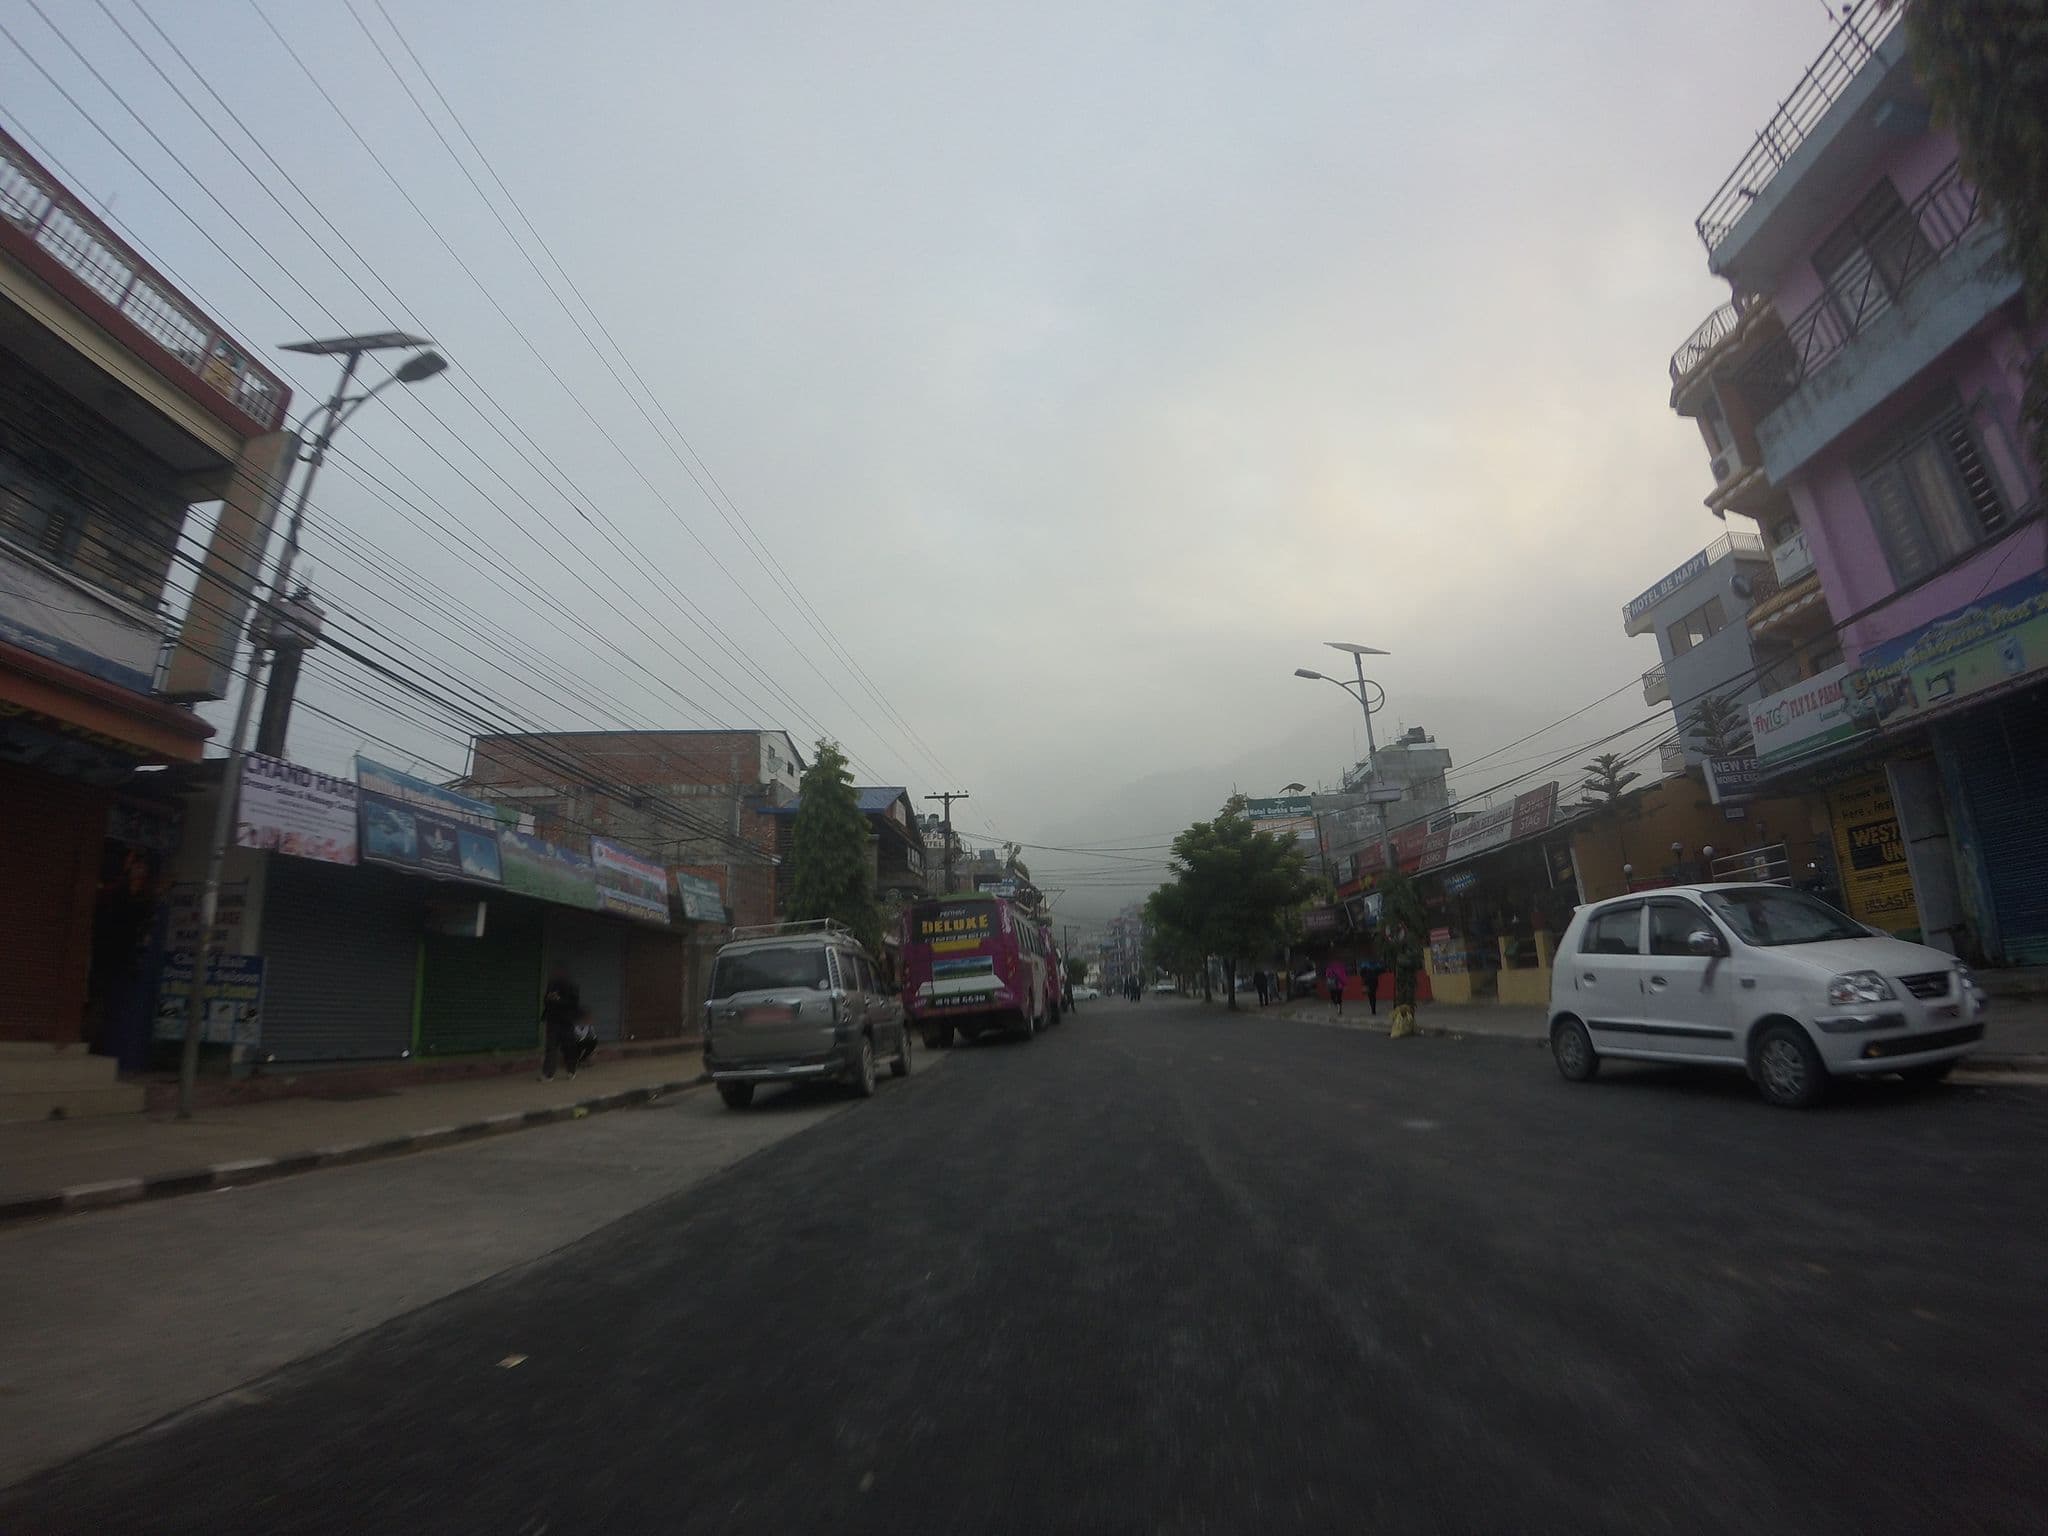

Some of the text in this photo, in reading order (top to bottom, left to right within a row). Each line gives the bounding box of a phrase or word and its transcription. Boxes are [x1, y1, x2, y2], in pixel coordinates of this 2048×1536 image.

[1630, 553, 1706, 615] HOTEL BE HAPPY
[1711, 759, 1740, 773] NEW
[1519, 814, 1541, 831] STAG
[921, 913, 989, 934] DELUXE
